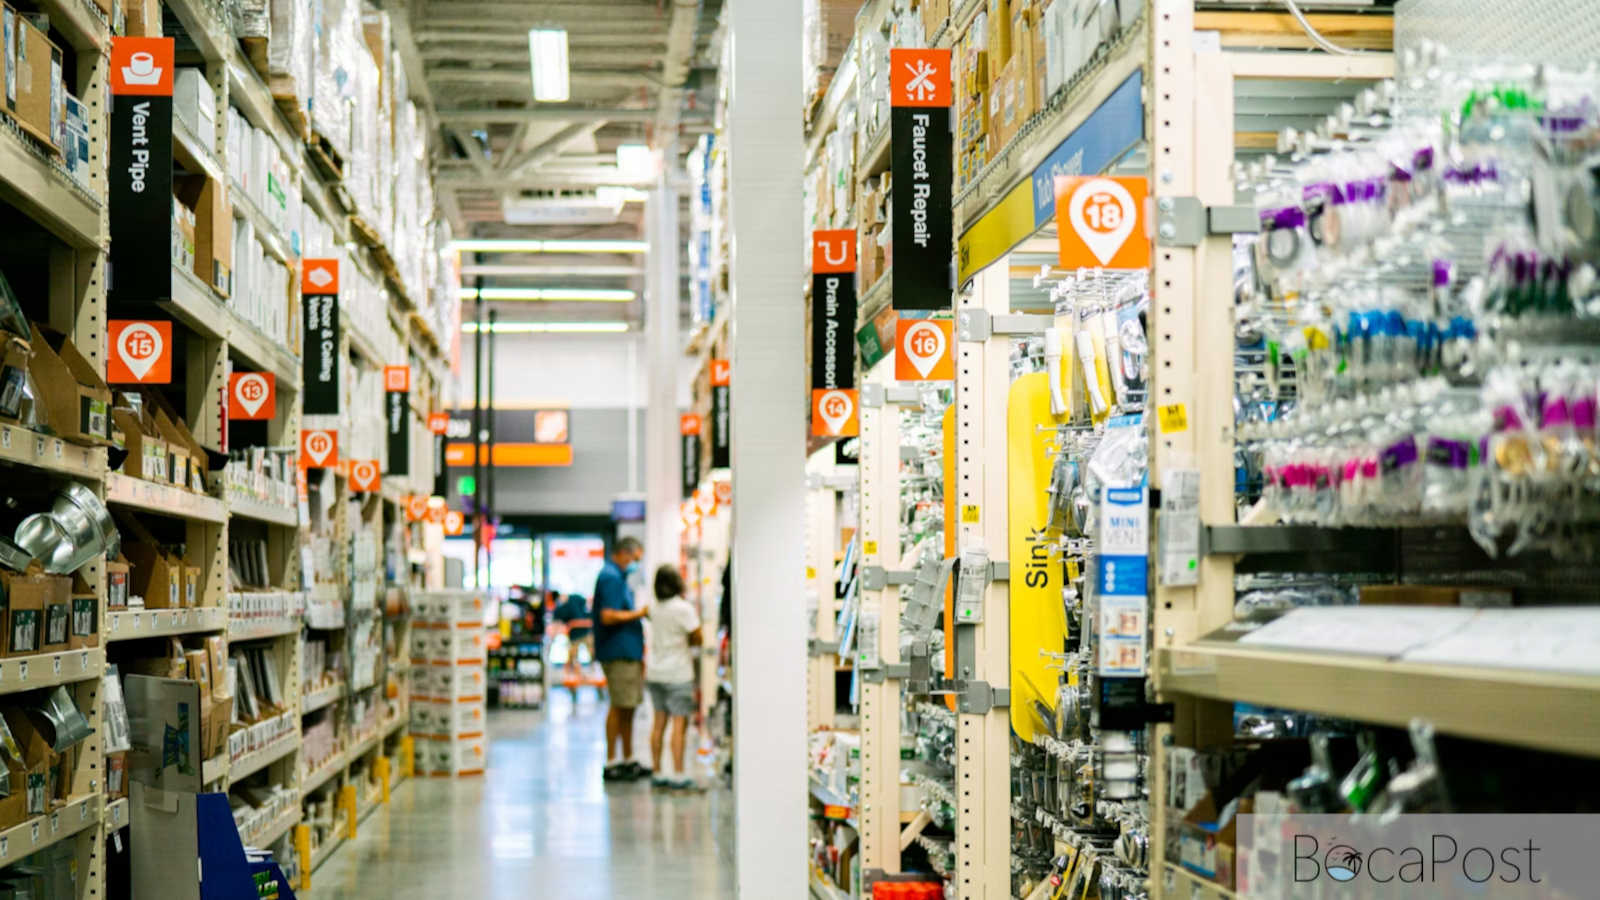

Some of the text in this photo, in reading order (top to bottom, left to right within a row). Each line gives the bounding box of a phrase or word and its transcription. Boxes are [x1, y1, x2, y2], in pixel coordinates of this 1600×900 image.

[127, 101, 151, 194] Vent Pipe
[910, 113, 932, 249] Faucet Repair
[1085, 204, 1122, 230] 18
[824, 277, 840, 318] Drain
[128, 339, 153, 356] 15
[913, 337, 937, 354] 16
[243, 386, 262, 399] 13
[828, 402, 844, 415] 14
[1025, 525, 1049, 589] Sink
